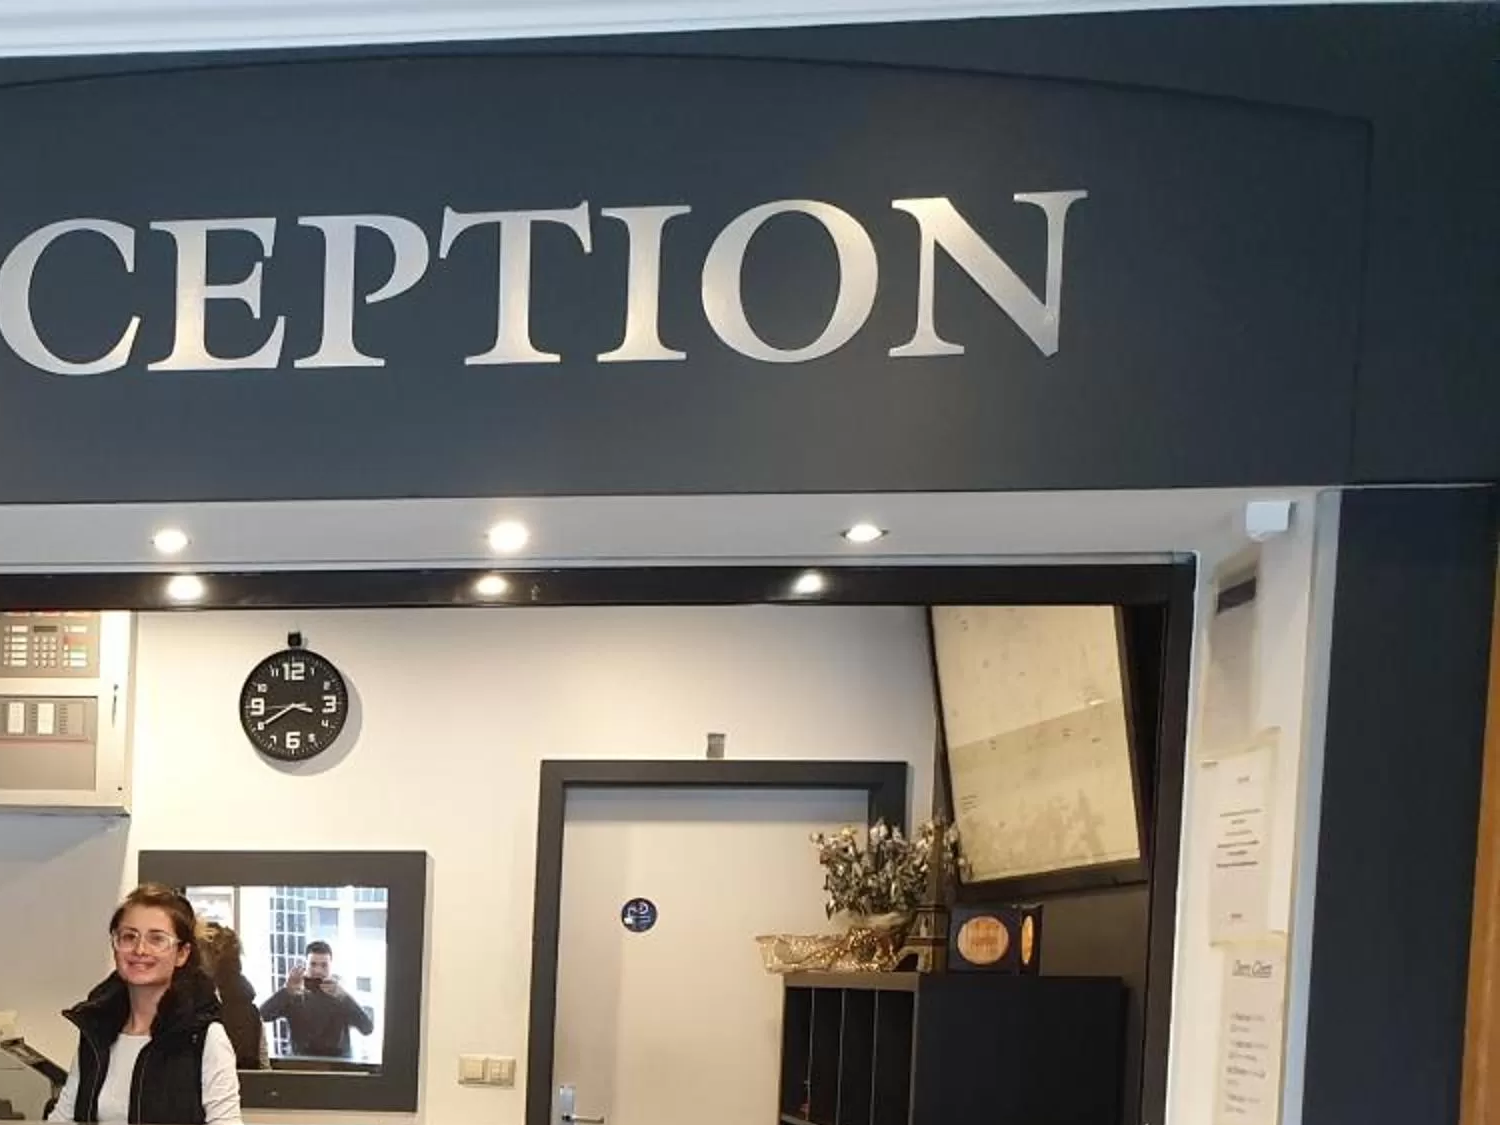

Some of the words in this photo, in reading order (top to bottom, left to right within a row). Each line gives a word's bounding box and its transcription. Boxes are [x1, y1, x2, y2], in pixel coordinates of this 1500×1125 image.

[282, 662, 305, 680] 12
[250, 697, 265, 716] 9
[322, 695, 337, 713] 3
[285, 731, 301, 749] 6
